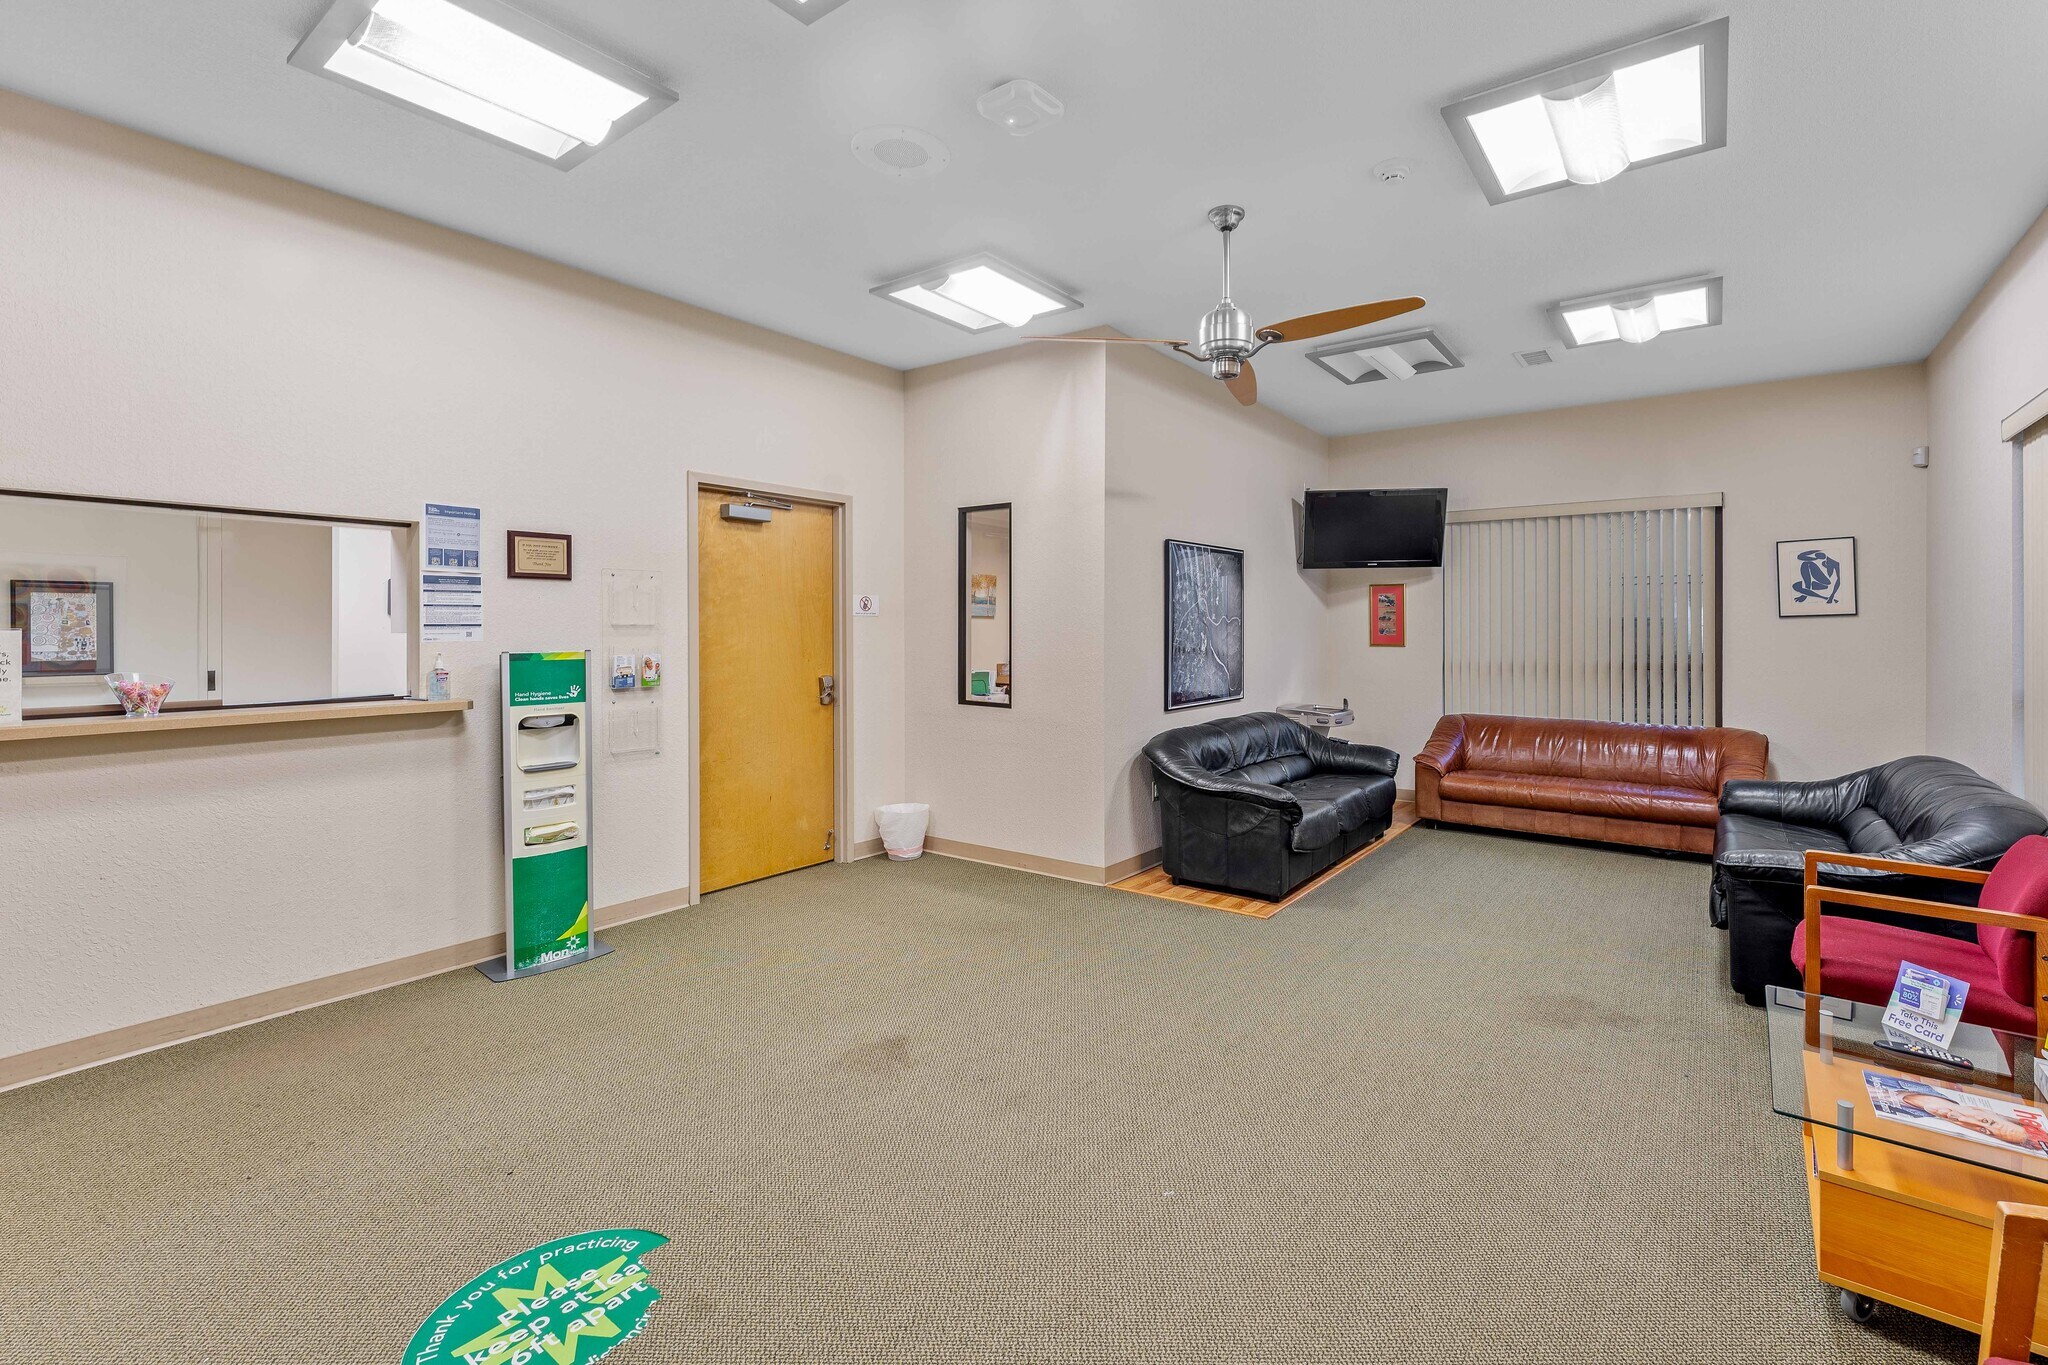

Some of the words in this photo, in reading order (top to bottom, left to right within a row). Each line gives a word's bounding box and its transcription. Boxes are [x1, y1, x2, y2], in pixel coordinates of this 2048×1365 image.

[541, 949, 570, 962] Mon
[1902, 991, 1918, 1002] 80%
[1888, 1013, 1912, 1030] Free
[1914, 1024, 1945, 1043] Card
[1900, 1009, 1919, 1022] Take
[1921, 1017, 1939, 1030] This
[416, 1314, 461, 1365] Thank
[456, 1281, 496, 1311] you
[497, 1259, 531, 1280] for
[539, 1236, 640, 1264] practicing
[497, 1268, 599, 1328] Please
[569, 1280, 649, 1333] apart
[463, 1315, 551, 1365] keep
[560, 1290, 593, 1314] at
